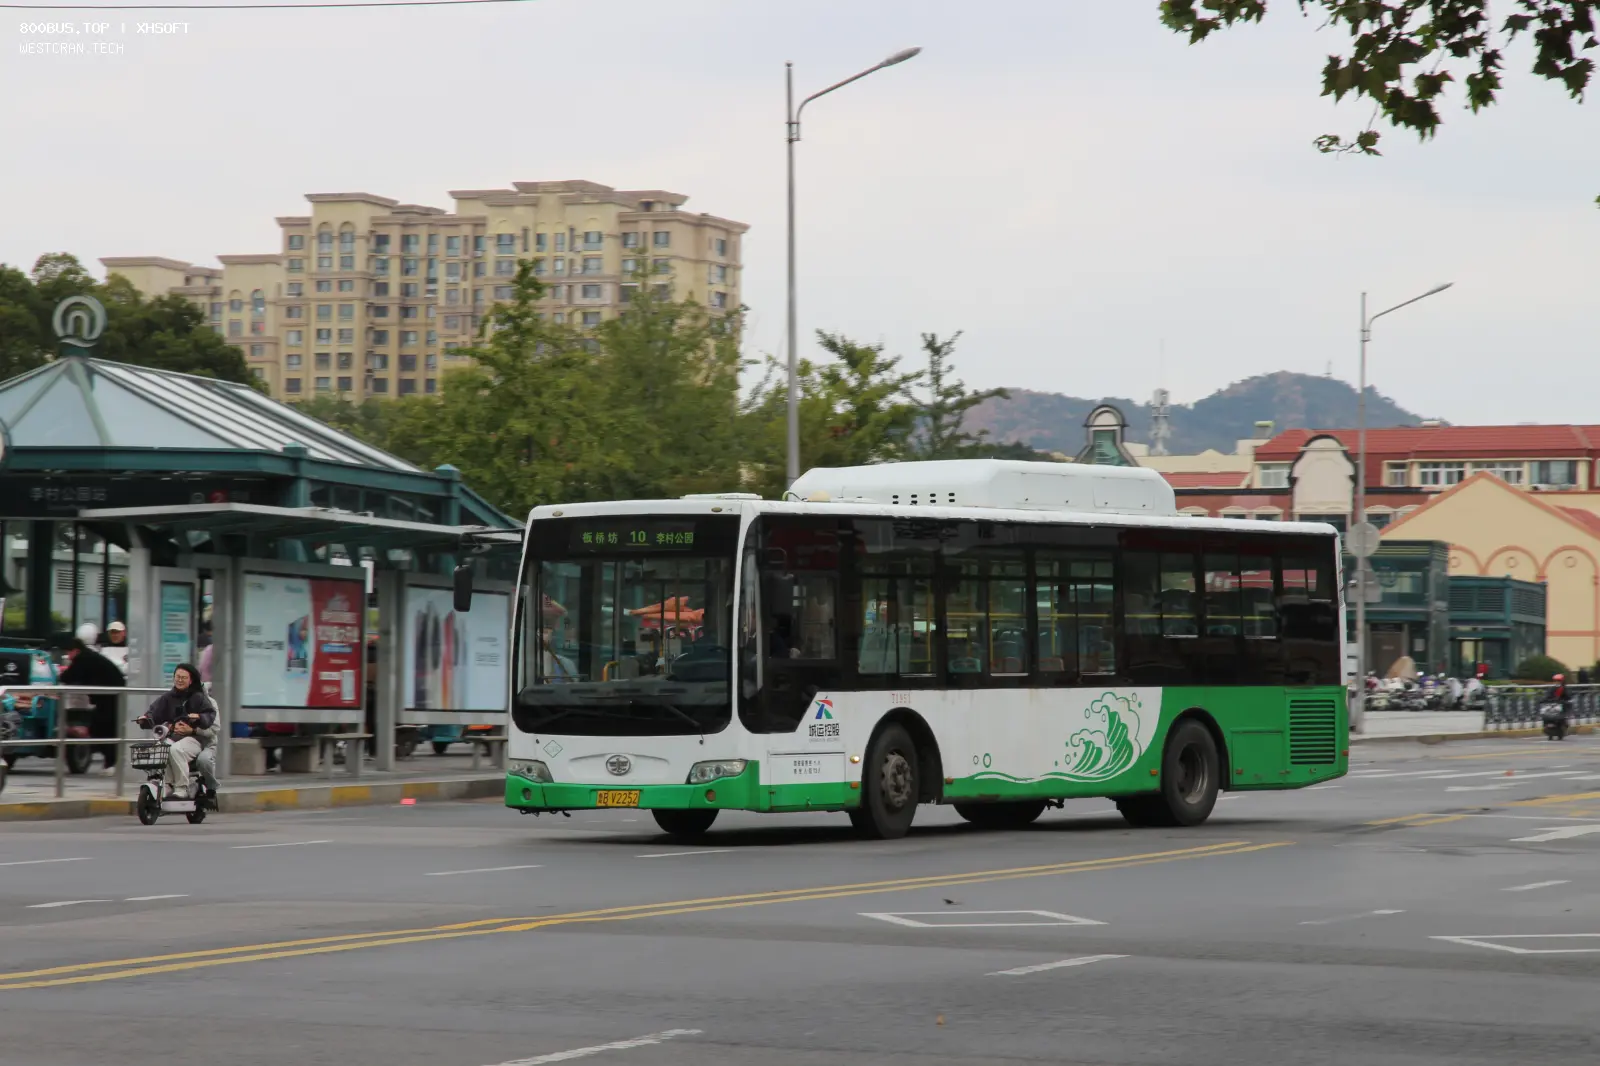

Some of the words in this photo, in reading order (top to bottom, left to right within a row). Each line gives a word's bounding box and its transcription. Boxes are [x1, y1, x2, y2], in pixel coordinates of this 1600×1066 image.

[630, 530, 647, 543] 10
[656, 532, 694, 545] 李村公园
[808, 723, 840, 737] 城运控股
